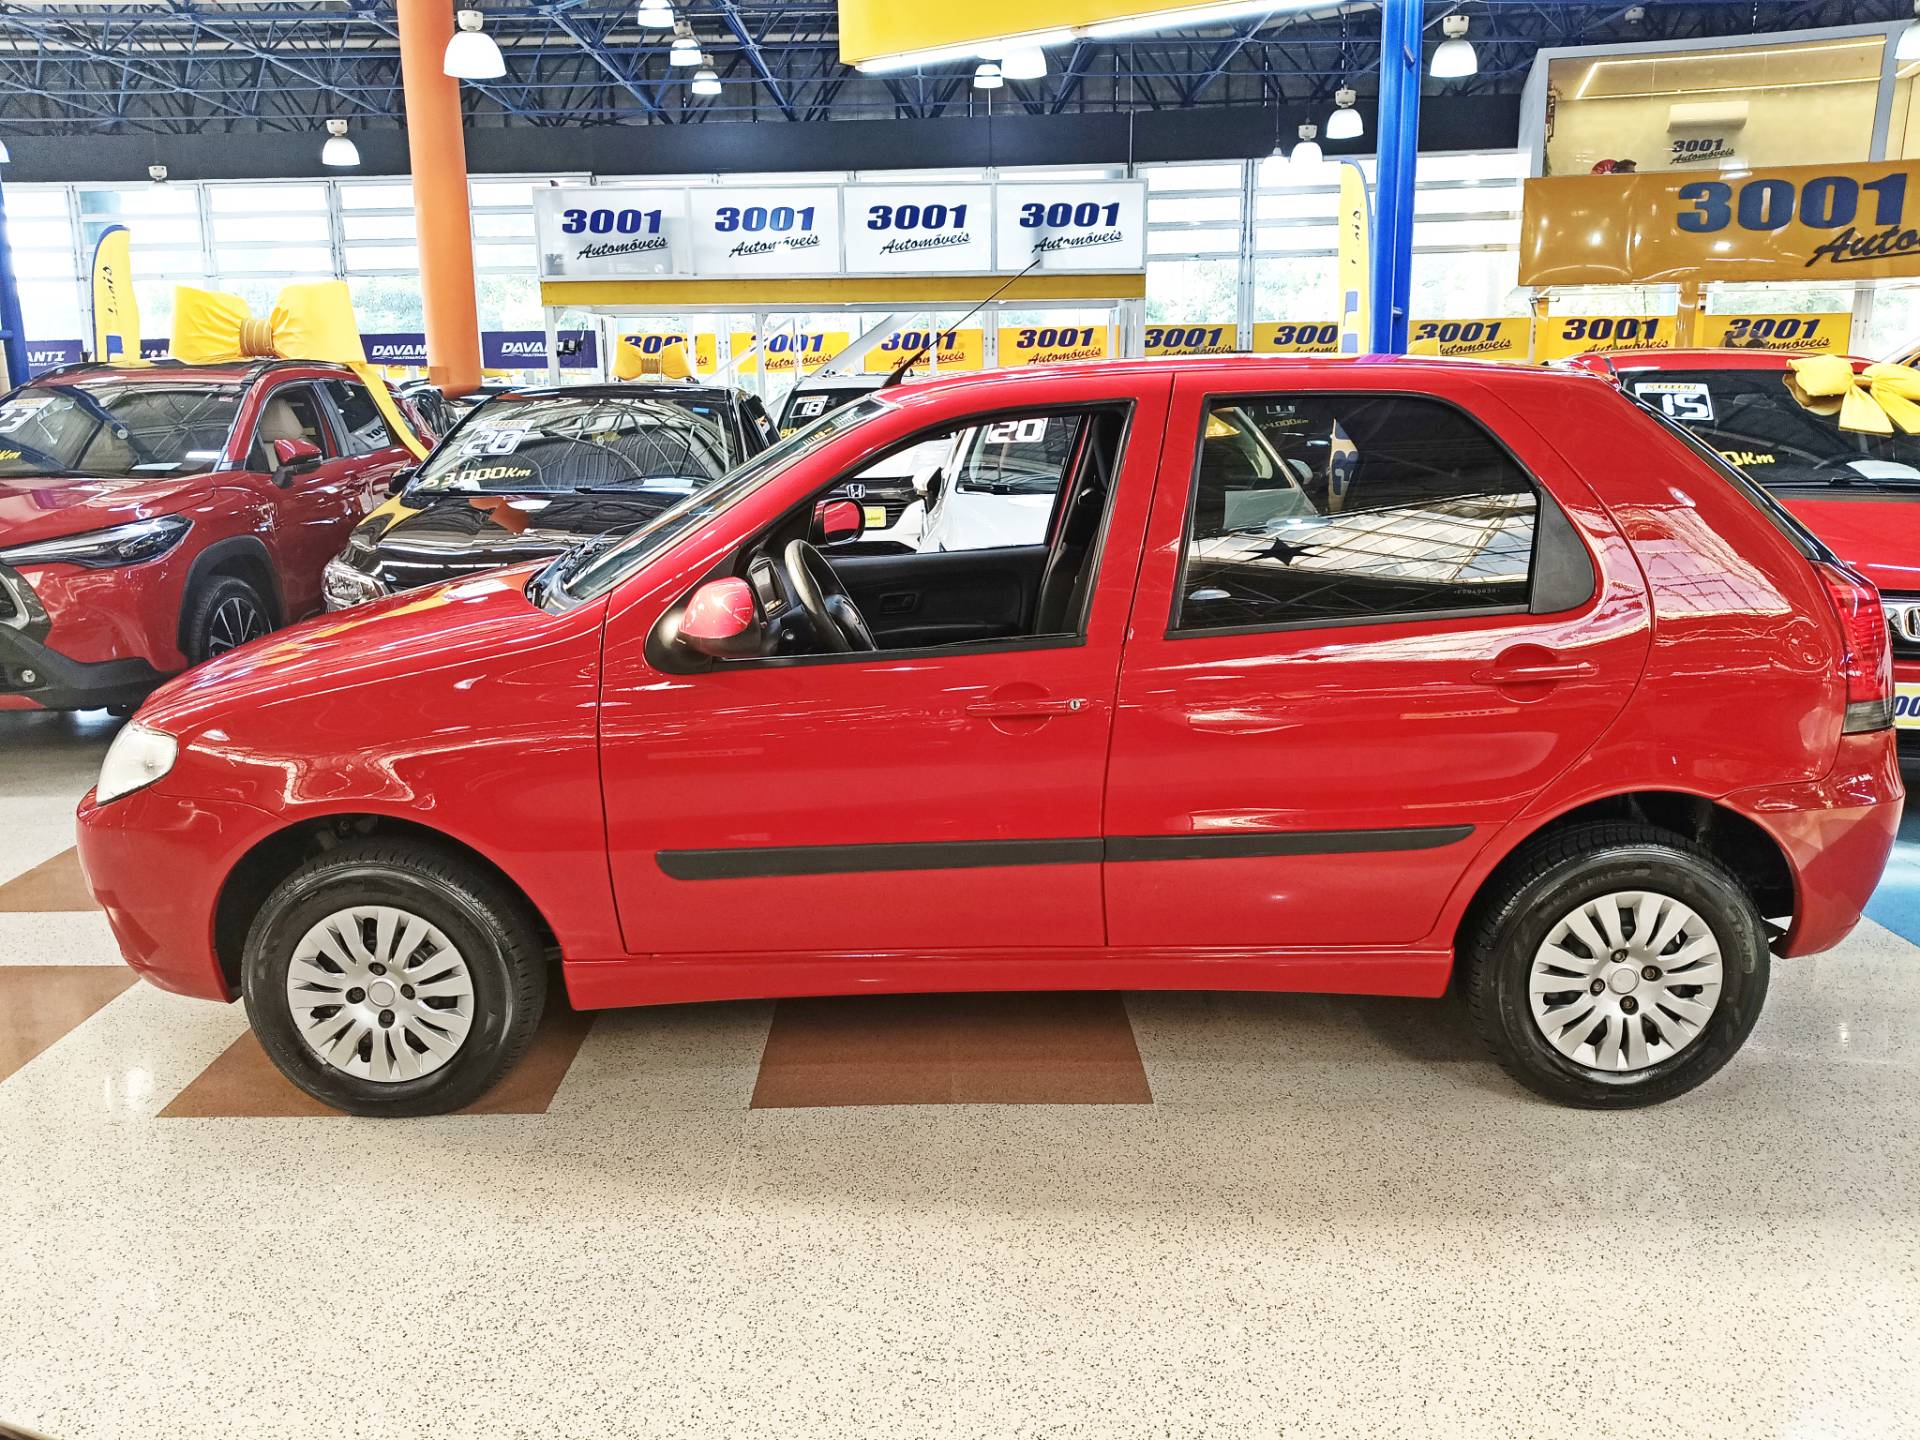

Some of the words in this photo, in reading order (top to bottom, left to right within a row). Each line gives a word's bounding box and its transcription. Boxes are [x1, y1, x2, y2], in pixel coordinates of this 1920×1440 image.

[1672, 138, 1724, 152] 3001
[1677, 173, 1908, 233] 3001
[562, 209, 662, 234] 3001
[715, 206, 815, 232] 3001
[867, 204, 967, 230] 3001
[1019, 202, 1120, 228] 3001
[577, 236, 669, 259] Automóveis
[880, 232, 972, 254] Automóveis
[1017, 328, 1094, 348] 3001
[1144, 328, 1224, 348] 3001
[1415, 322, 1502, 342] 3001
[1562, 318, 1660, 340] 3001
[751, 334, 824, 352] 001
[1439, 338, 1512, 356] utomóveis
[1766, 337, 1831, 350] omóveis
[1027, 346, 1102, 365] Automóveis
[801, 402, 824, 415] 18
[1662, 394, 1709, 418] 15
[463, 429, 525, 453] 20
[990, 419, 1044, 441] 20
